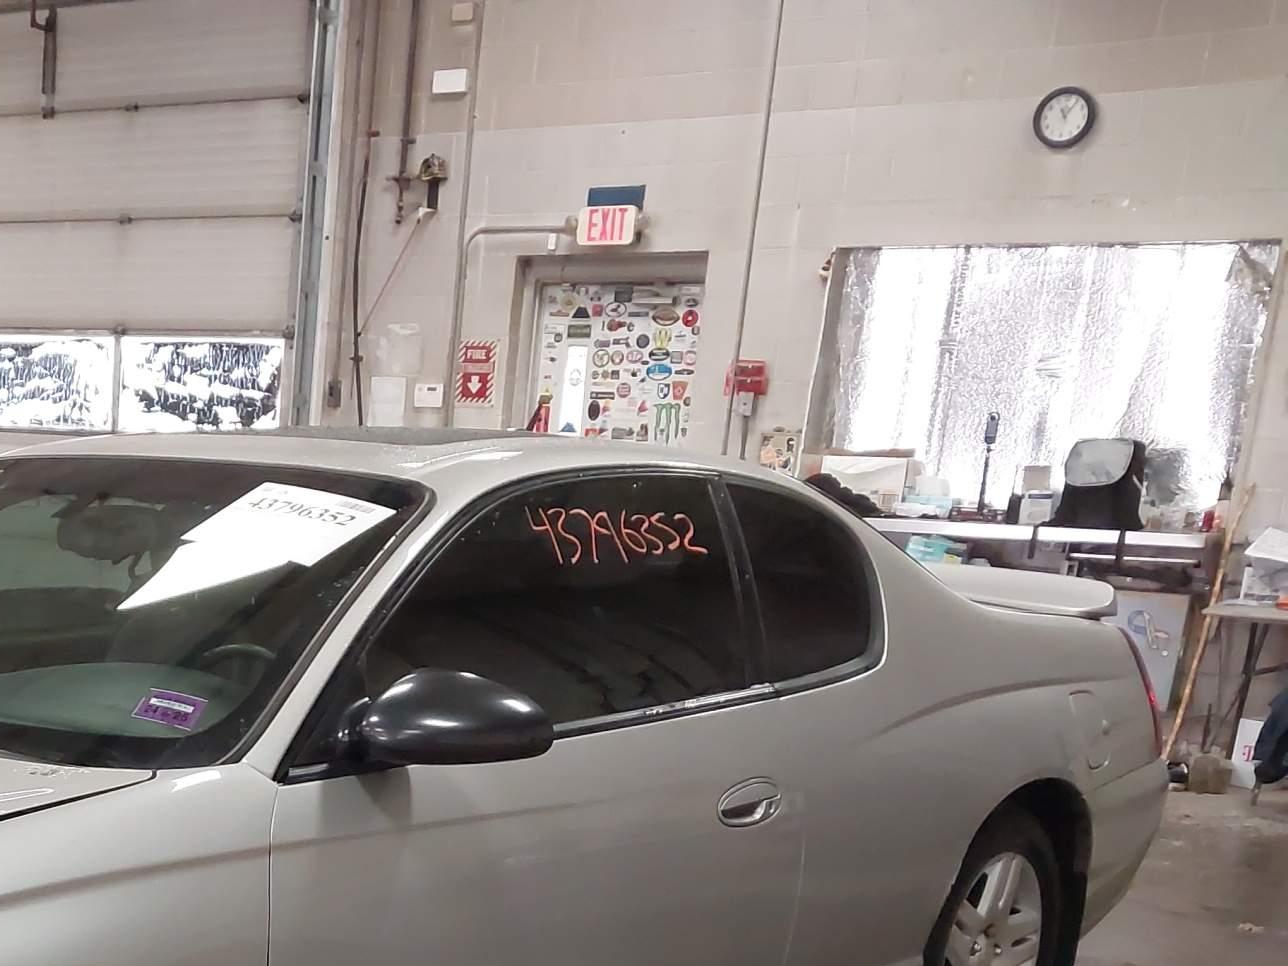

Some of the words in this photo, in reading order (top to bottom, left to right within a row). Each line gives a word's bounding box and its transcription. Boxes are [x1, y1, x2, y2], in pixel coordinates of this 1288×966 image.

[587, 208, 628, 241] EXIT
[466, 349, 488, 360] FIRE
[249, 497, 357, 526] 43796352
[524, 505, 709, 565] 43796352
